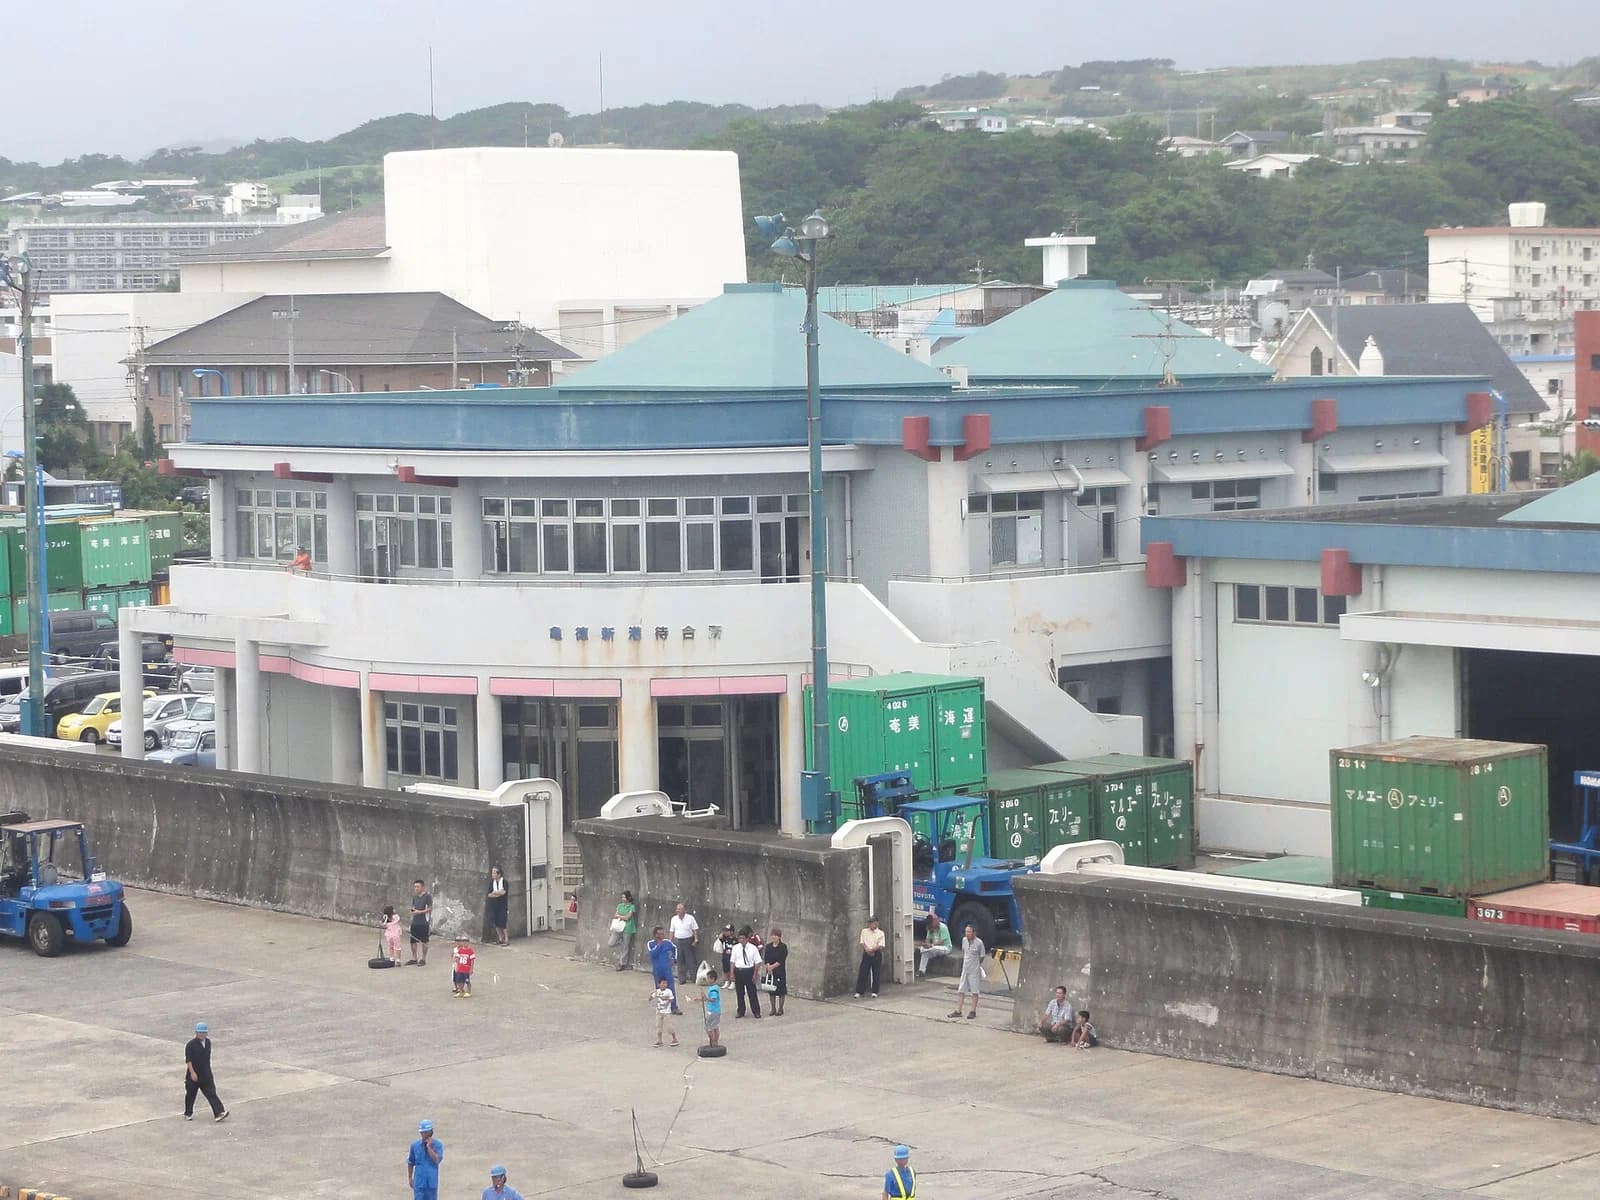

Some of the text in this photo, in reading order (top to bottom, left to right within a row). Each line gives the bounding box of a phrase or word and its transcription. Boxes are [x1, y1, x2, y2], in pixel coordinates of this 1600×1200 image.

[886, 699, 908, 710] 4026
[888, 714, 920, 733] 奄美
[944, 707, 974, 726] 海運
[1338, 758, 1367, 769] 2814
[1477, 907, 1504, 920] 3673
